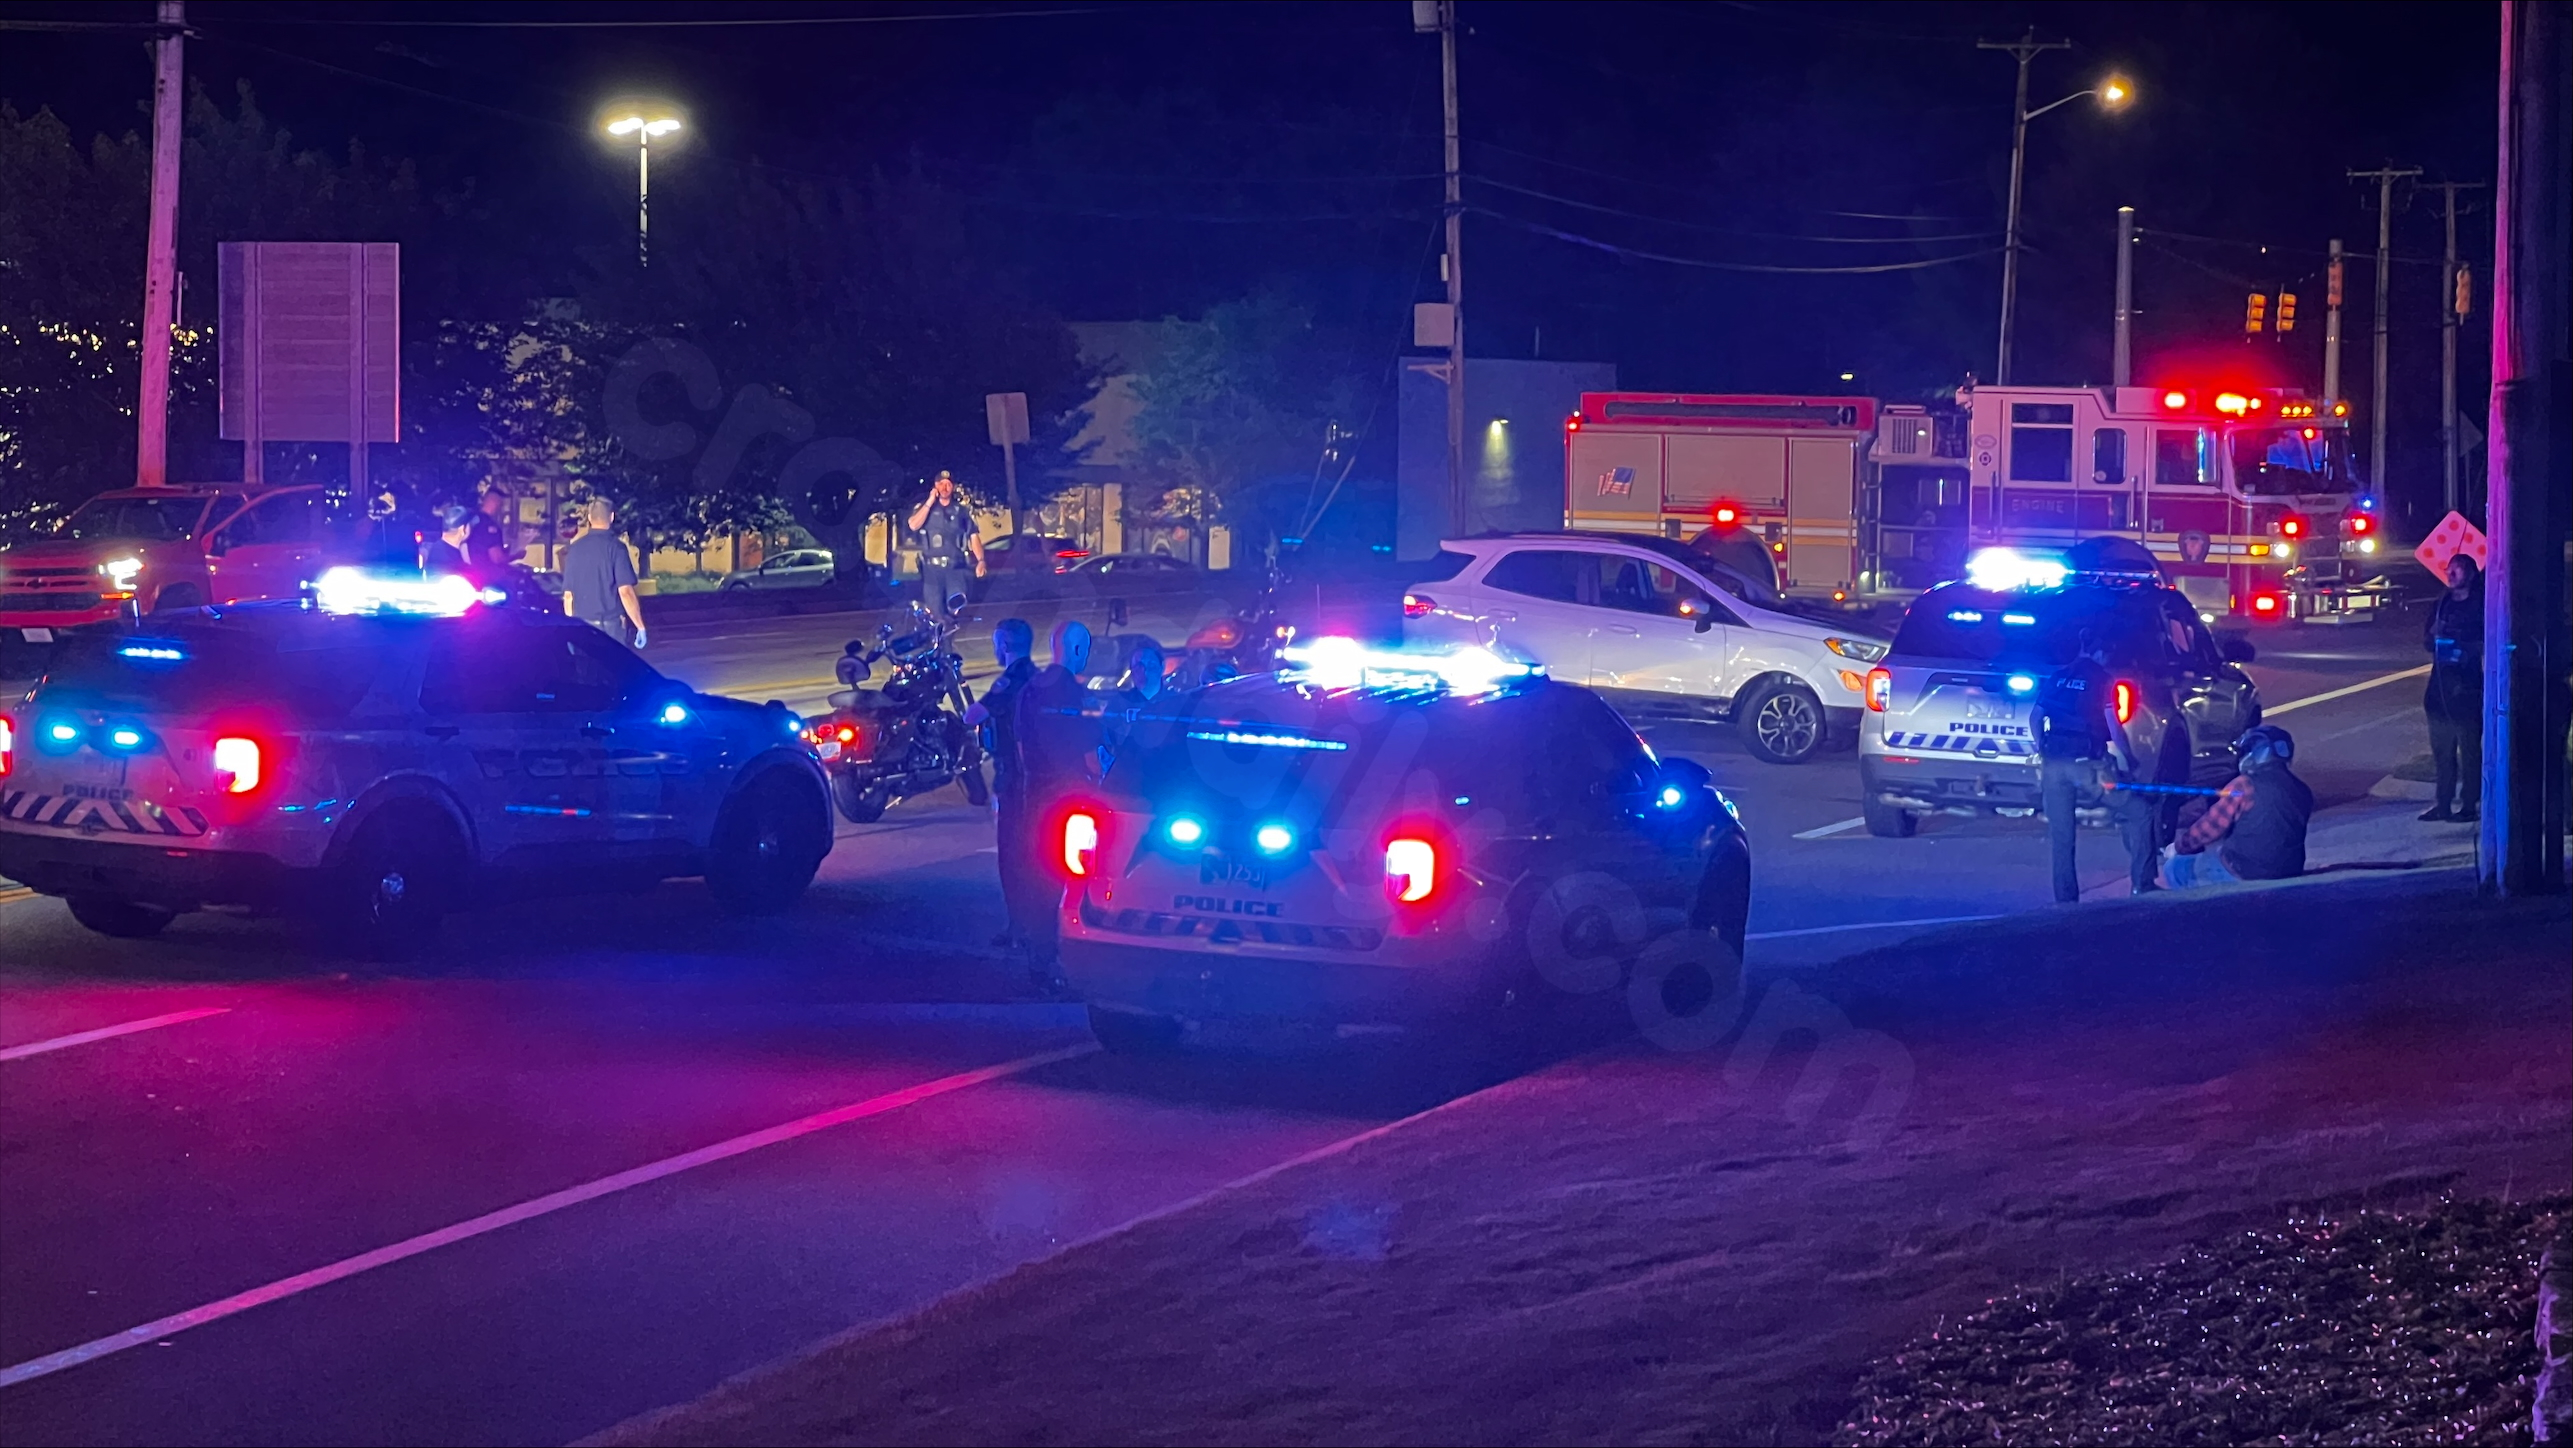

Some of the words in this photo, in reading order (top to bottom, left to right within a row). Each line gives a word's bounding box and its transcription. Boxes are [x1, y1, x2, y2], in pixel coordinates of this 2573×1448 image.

[2010, 498, 2065, 514] ENGINE
[1949, 722, 2029, 738] POLICE
[62, 783, 135, 801] POLICE
[1173, 894, 1285, 917] POLICE
